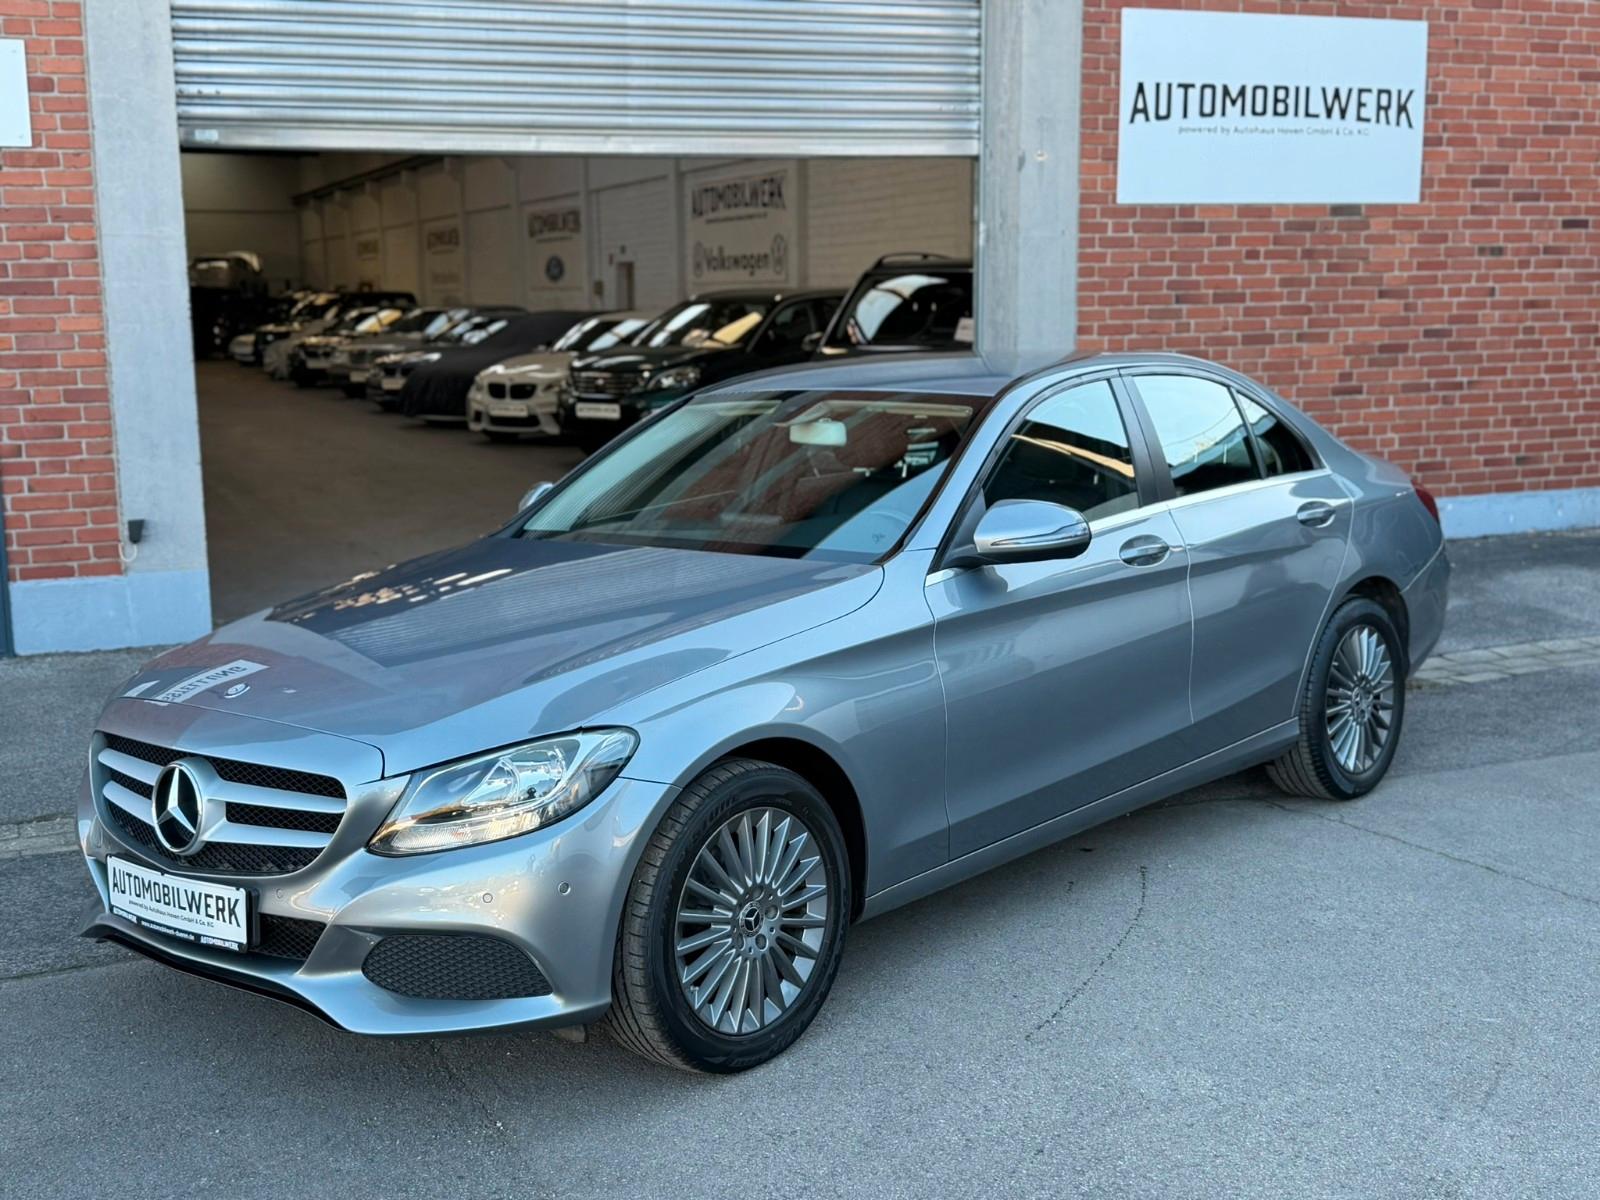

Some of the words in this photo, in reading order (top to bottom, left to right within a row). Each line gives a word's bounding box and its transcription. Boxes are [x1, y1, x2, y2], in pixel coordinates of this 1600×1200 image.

[1129, 81, 1415, 129] AUTOMOBILWERK
[1178, 125, 1218, 135] powered
[1220, 126, 1230, 136] by
[1233, 126, 1275, 135] Autohaus
[704, 245, 769, 277] Volkswagen
[112, 867, 241, 928] AUTOMOBILWERK
